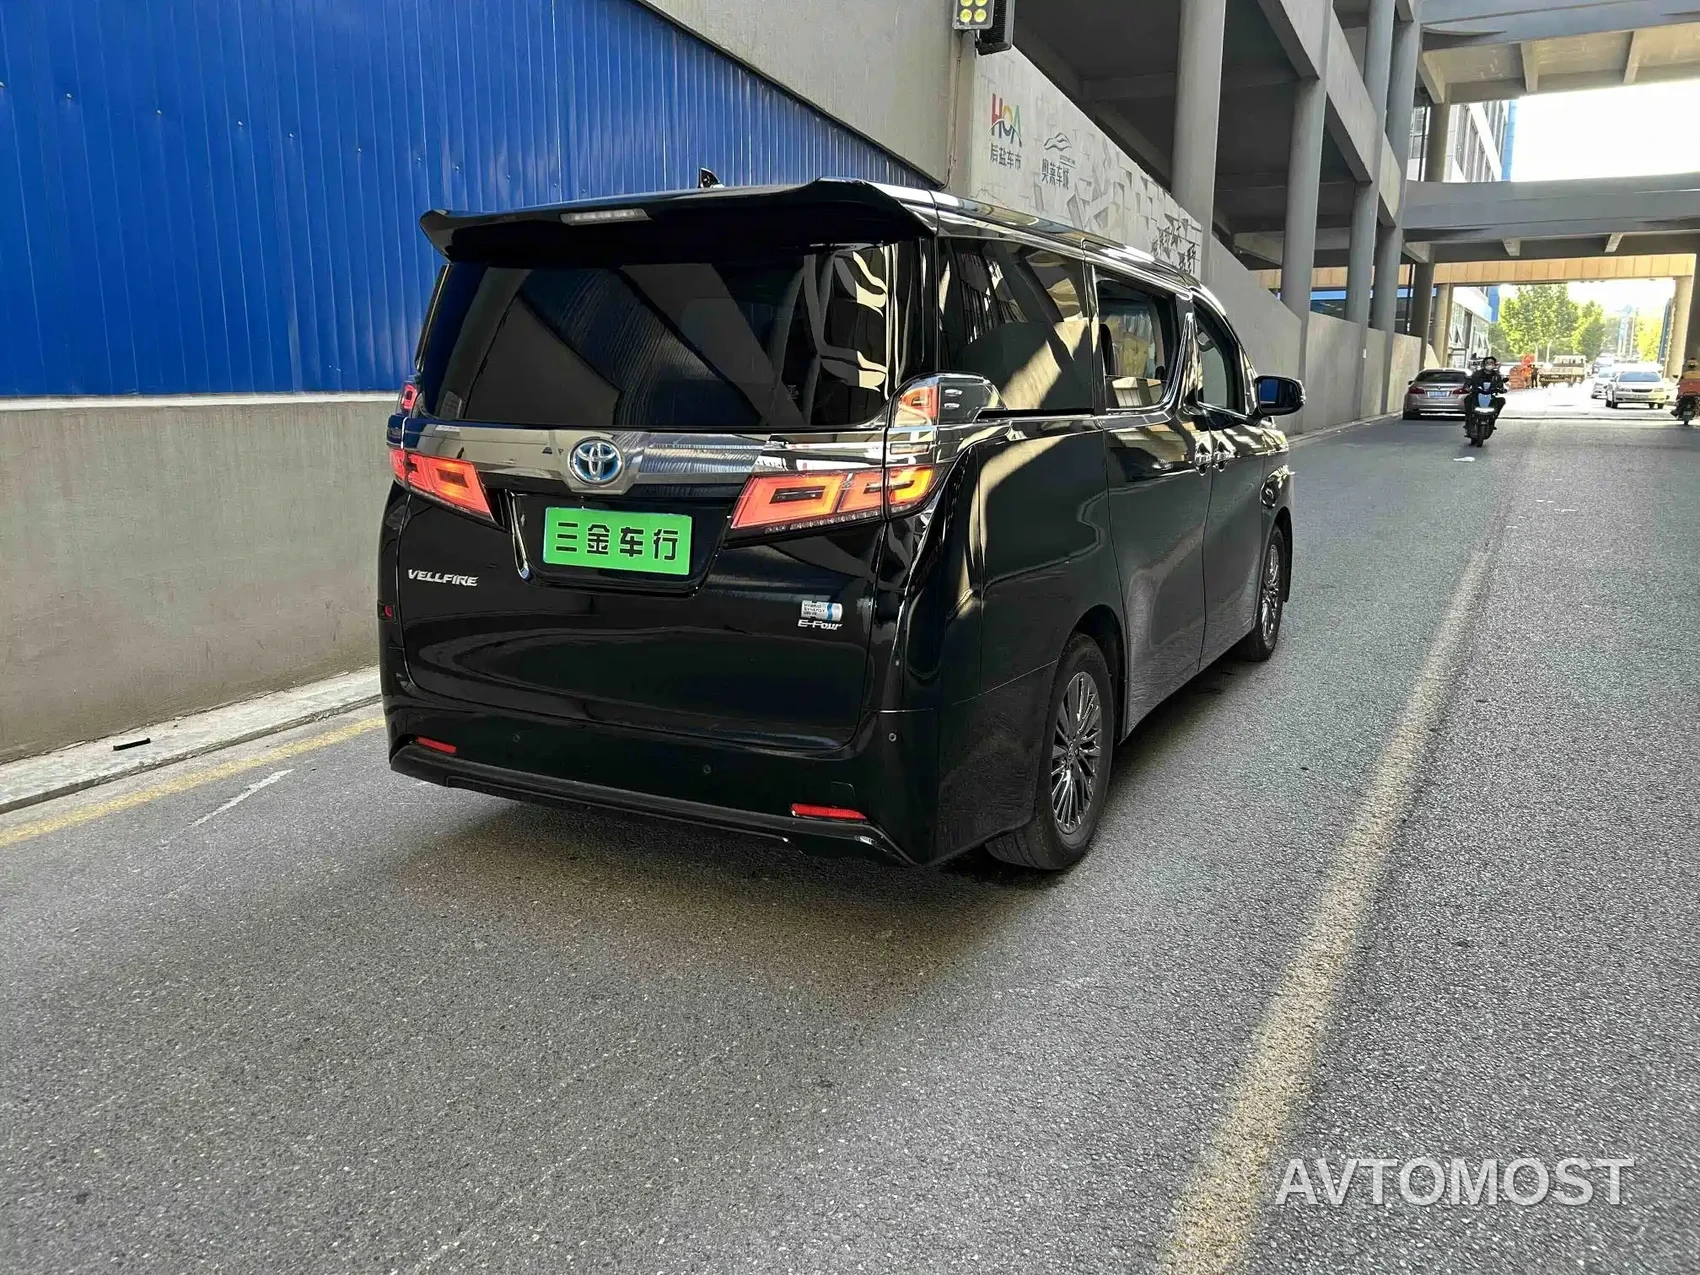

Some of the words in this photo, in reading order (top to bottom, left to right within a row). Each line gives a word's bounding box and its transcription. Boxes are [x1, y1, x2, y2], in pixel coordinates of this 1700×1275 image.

[556, 522, 678, 561] 三金车行
[408, 569, 479, 587] VELLFIRE
[798, 619, 842, 630] E-Four
